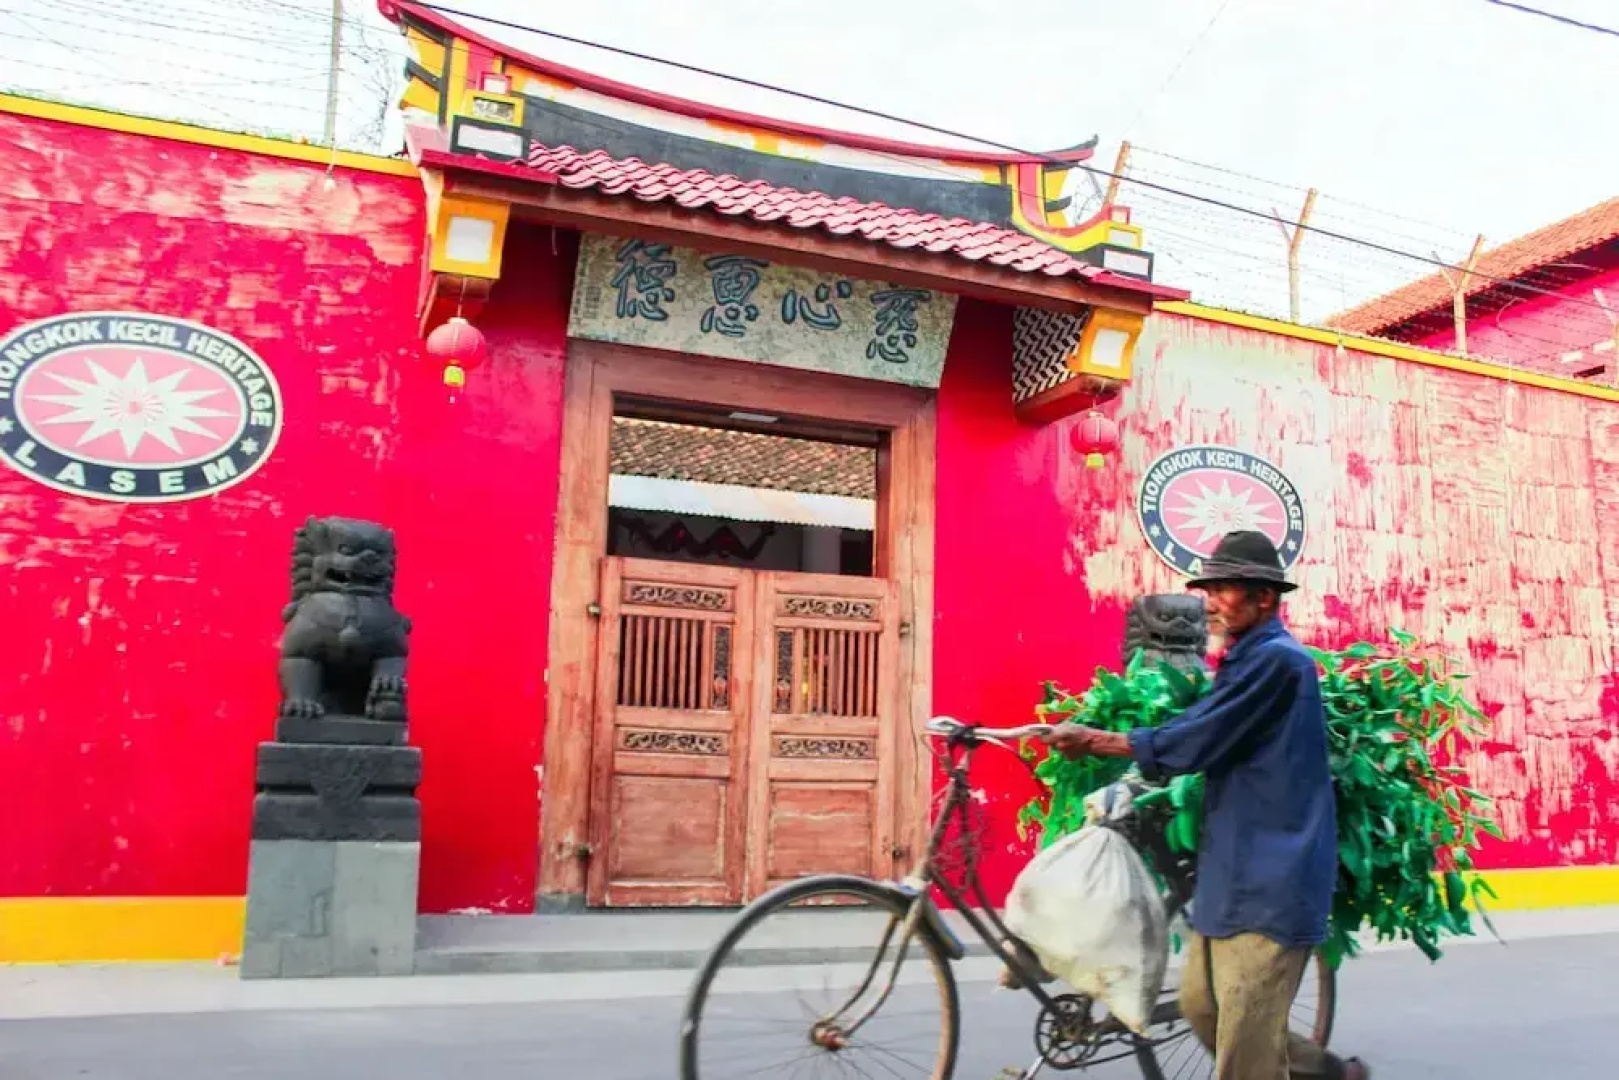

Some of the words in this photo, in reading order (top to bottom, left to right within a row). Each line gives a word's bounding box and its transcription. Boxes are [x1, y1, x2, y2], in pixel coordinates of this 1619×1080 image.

[109, 322, 182, 347] KECIL
[188, 334, 273, 427] HERITAGE
[13, 442, 237, 493] LASEM
[1143, 452, 1203, 512] TIONGKOK
[1207, 452, 1247, 471] KECIL
[1250, 461, 1302, 531] HERITAGE
